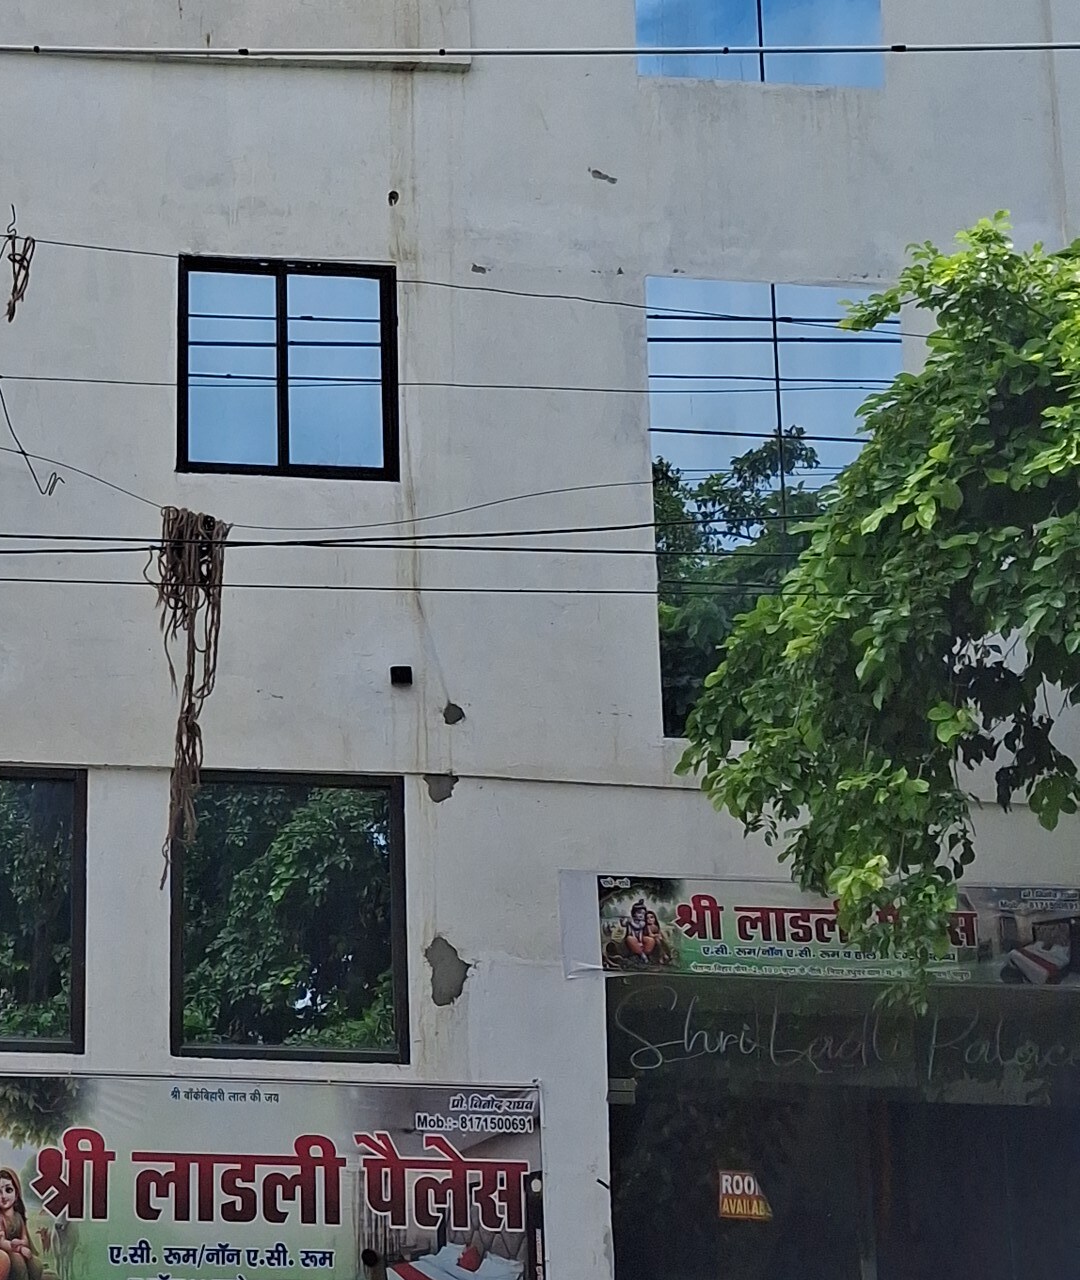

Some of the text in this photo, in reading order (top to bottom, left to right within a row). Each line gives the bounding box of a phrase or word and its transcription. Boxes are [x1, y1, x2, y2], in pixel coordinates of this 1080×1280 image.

[674, 894, 723, 940] श्री
[734, 899, 852, 944] लाडल
[702, 944, 731, 956] ए.सी.
[787, 947, 816, 958] ए.सी.
[820, 949, 840, 959] रूम
[249, 1089, 261, 1103] की
[264, 1093, 280, 1103] जय
[460, 1115, 534, 1133] 8171500691
[31, 1128, 530, 1231] श्री लाडली पैलेस
[722, 1198, 772, 1217] AVAILAB
[109, 1238, 334, 1268] ए.सी. रूम/नॉन ए.सी. रूम
